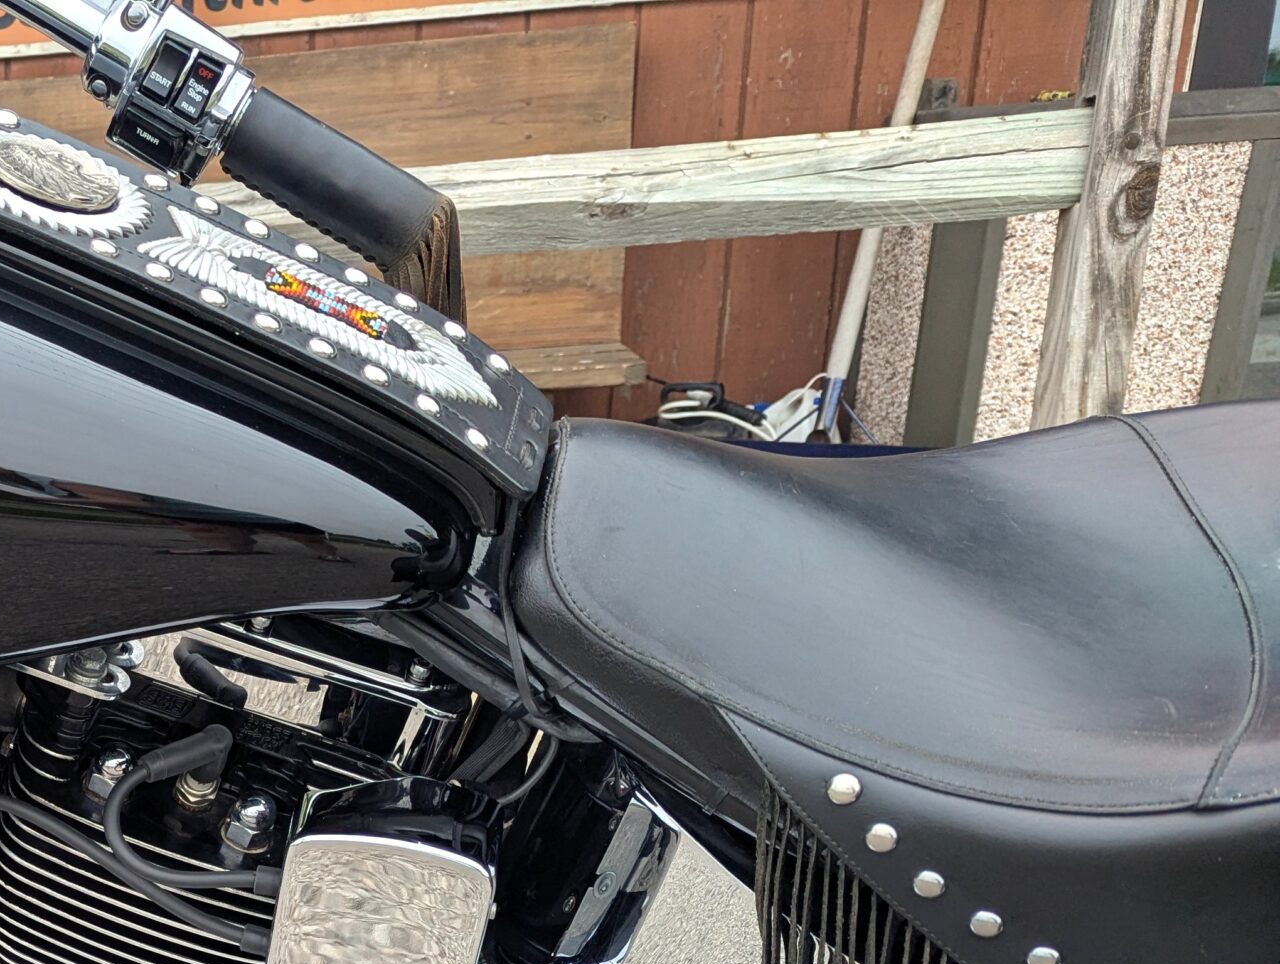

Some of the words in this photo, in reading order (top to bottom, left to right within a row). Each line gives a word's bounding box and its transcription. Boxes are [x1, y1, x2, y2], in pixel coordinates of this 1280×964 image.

[150, 71, 172, 88] START
[198, 67, 214, 79] OFF
[187, 87, 202, 102] Stop
[188, 78, 209, 96] Engine
[181, 101, 196, 114] RUN
